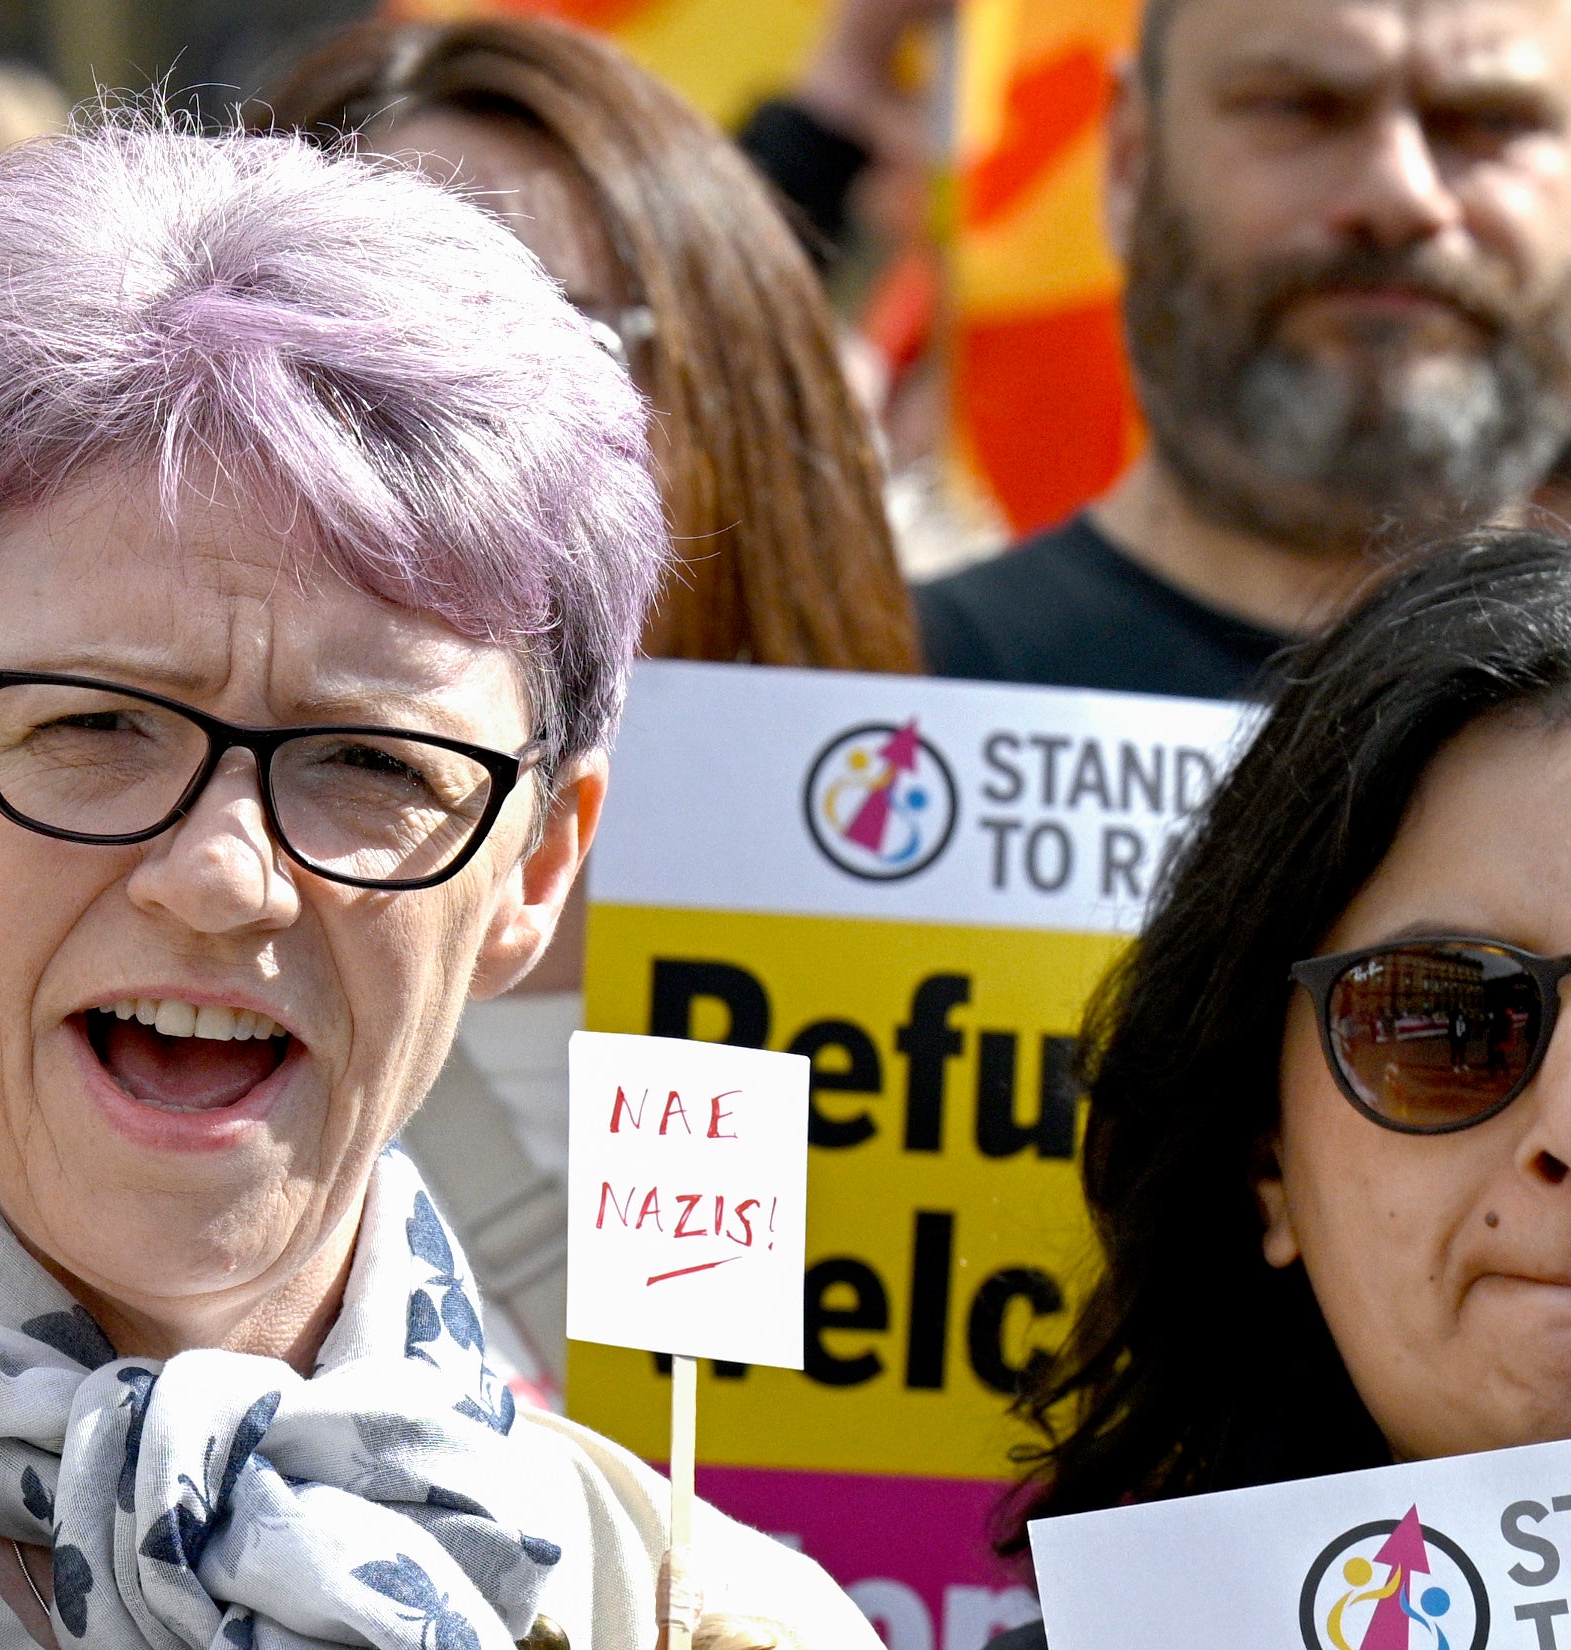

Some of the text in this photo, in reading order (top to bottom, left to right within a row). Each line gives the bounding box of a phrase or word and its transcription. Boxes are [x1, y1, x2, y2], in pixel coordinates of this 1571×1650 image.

[980, 817, 1074, 892] TO
[610, 1086, 743, 1138] NAE
[596, 1182, 777, 1250] NAZIS!
